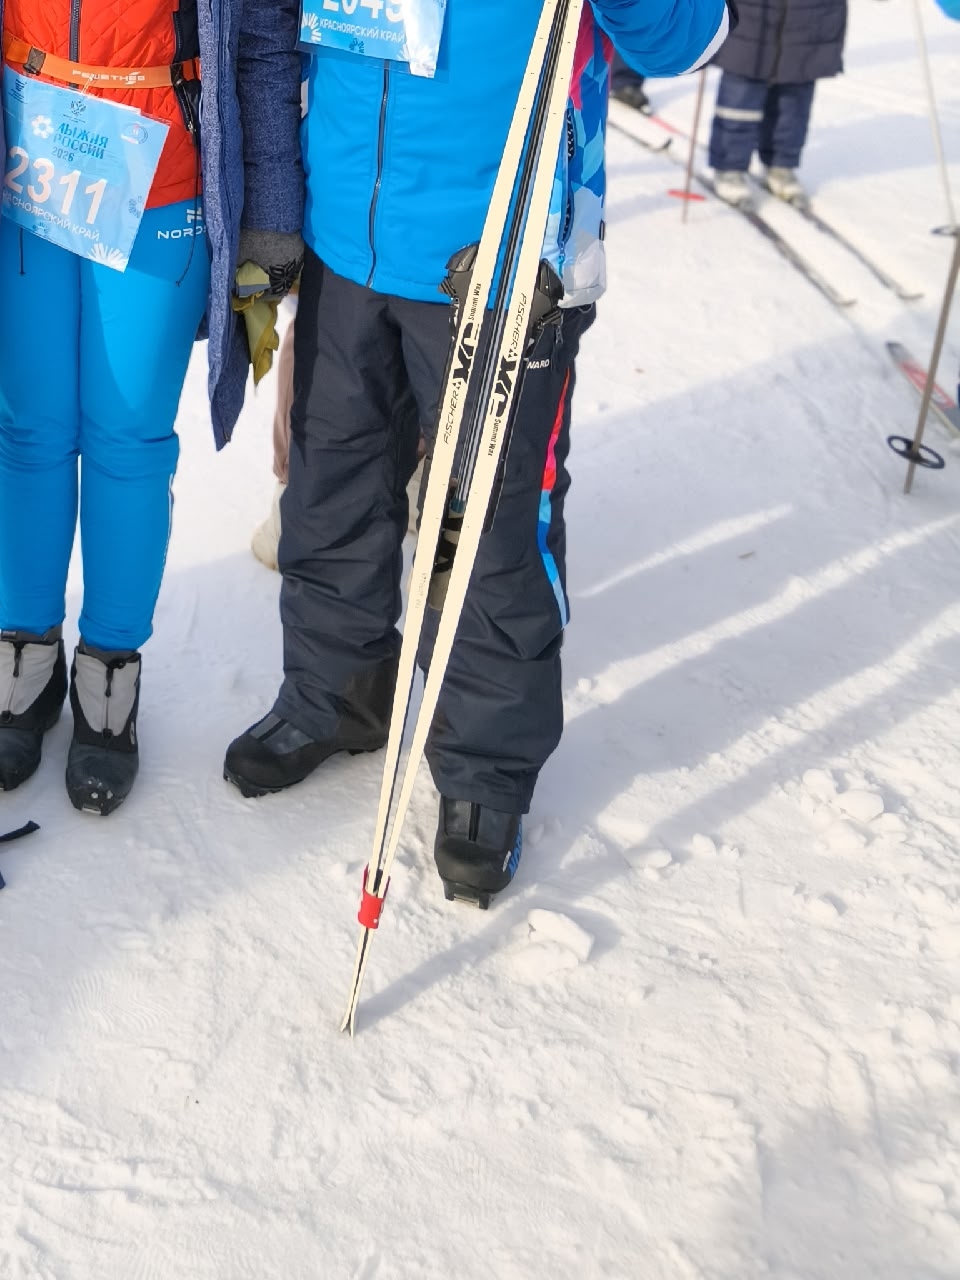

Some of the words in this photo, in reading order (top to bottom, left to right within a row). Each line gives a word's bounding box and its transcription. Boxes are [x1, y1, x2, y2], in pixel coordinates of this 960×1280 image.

[319, 18, 379, 39] КРАСНОЯРСКИЙ
[380, 29, 405, 42] КРАЙ
[53, 134, 105, 160] РОССИИ
[57, 122, 109, 148] ЛЫЖНЯ
[51, 146, 74, 162] 2026
[4, 145, 107, 225] 2311
[69, 223, 100, 241] КРАЙ
[157, 225, 207, 239] NORD
[511, 292, 528, 352] FISCHER
[444, 391, 459, 444] FISCHER
